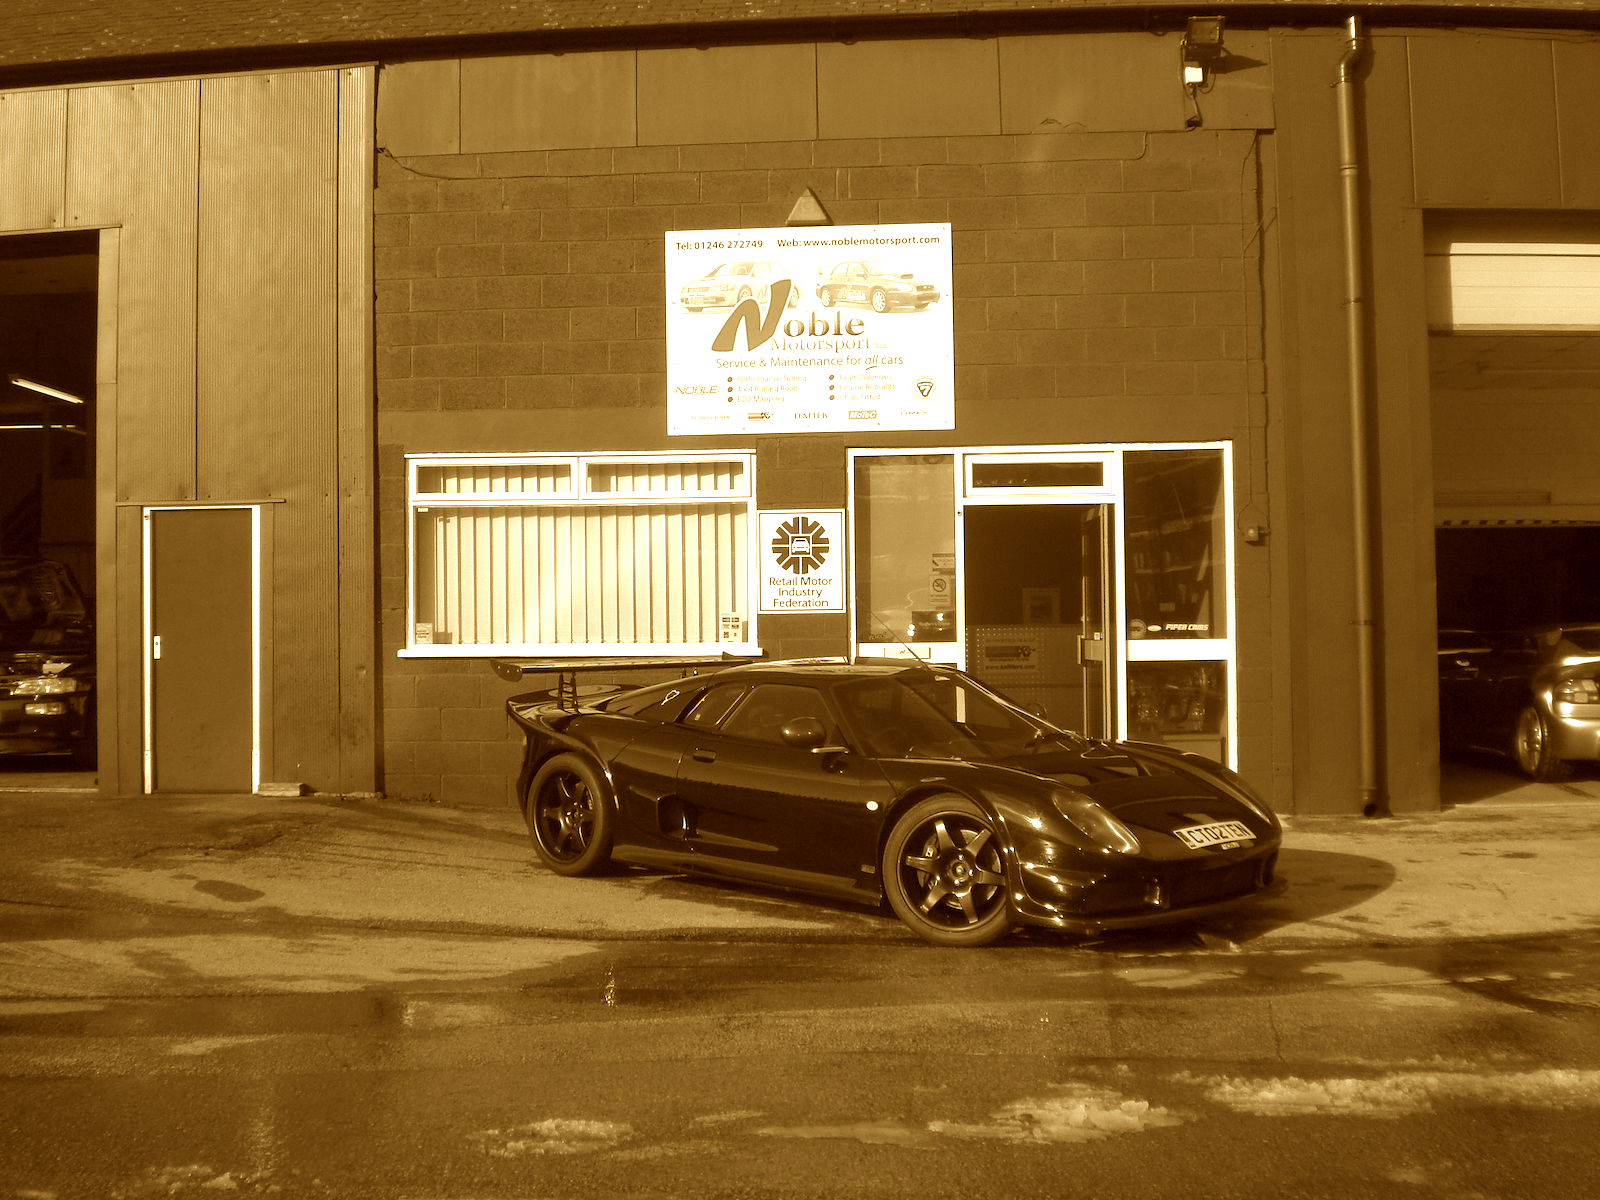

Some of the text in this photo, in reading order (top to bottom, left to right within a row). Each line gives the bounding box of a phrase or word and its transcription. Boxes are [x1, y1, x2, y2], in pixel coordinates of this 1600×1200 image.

[676, 236, 940, 250] Tel: 01246 272749 Web: www.noblemotorsport.com
[711, 279, 865, 352] Noble
[771, 336, 871, 354] Motorsport
[716, 355, 904, 369] Service & Maintenance for all cars
[736, 374, 807, 383] Performance Tuning
[857, 373, 893, 382] Diagnosis
[674, 385, 719, 395] NOBLE
[754, 385, 779, 394] Rolling
[780, 384, 799, 392] Road
[839, 383, 896, 392] Engine Rebuilds
[737, 395, 785, 404] ECU Mapping
[839, 393, 881, 402] Chips Fitted
[769, 576, 833, 586] Retail Motor
[778, 587, 823, 599] Industry
[773, 598, 829, 608] Federation
[1165, 623, 1188, 631] PIPER
